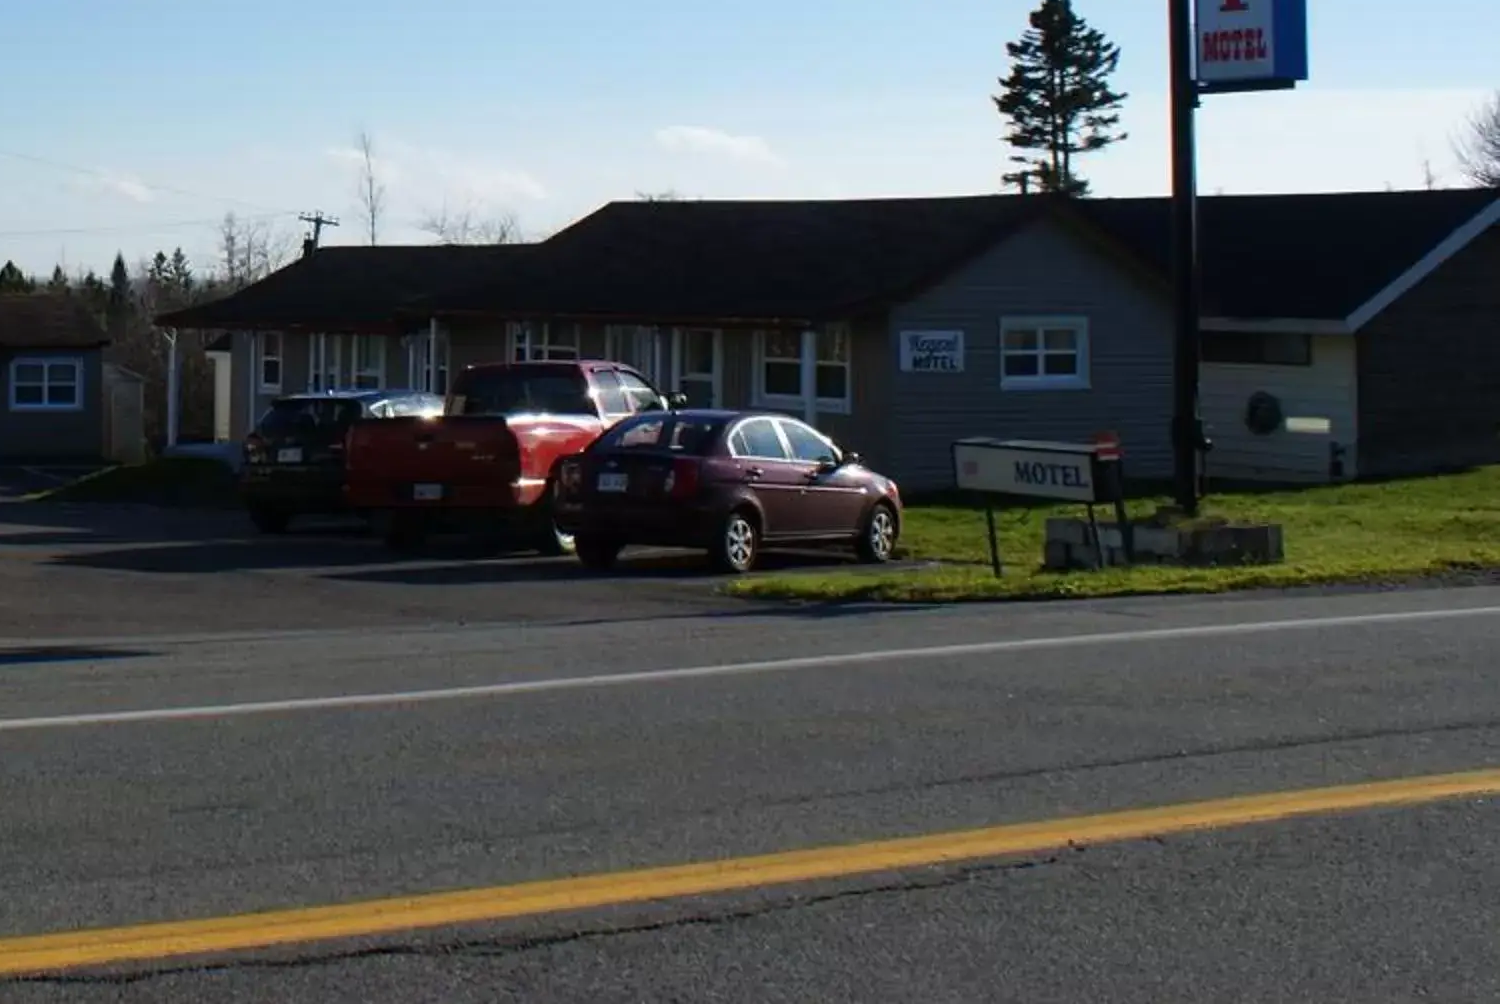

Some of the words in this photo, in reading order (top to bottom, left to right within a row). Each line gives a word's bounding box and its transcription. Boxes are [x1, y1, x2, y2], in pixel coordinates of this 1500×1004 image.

[1203, 28, 1267, 61] MOTEL
[912, 356, 957, 371] MOTEL
[1013, 460, 1089, 488] MOTEL
